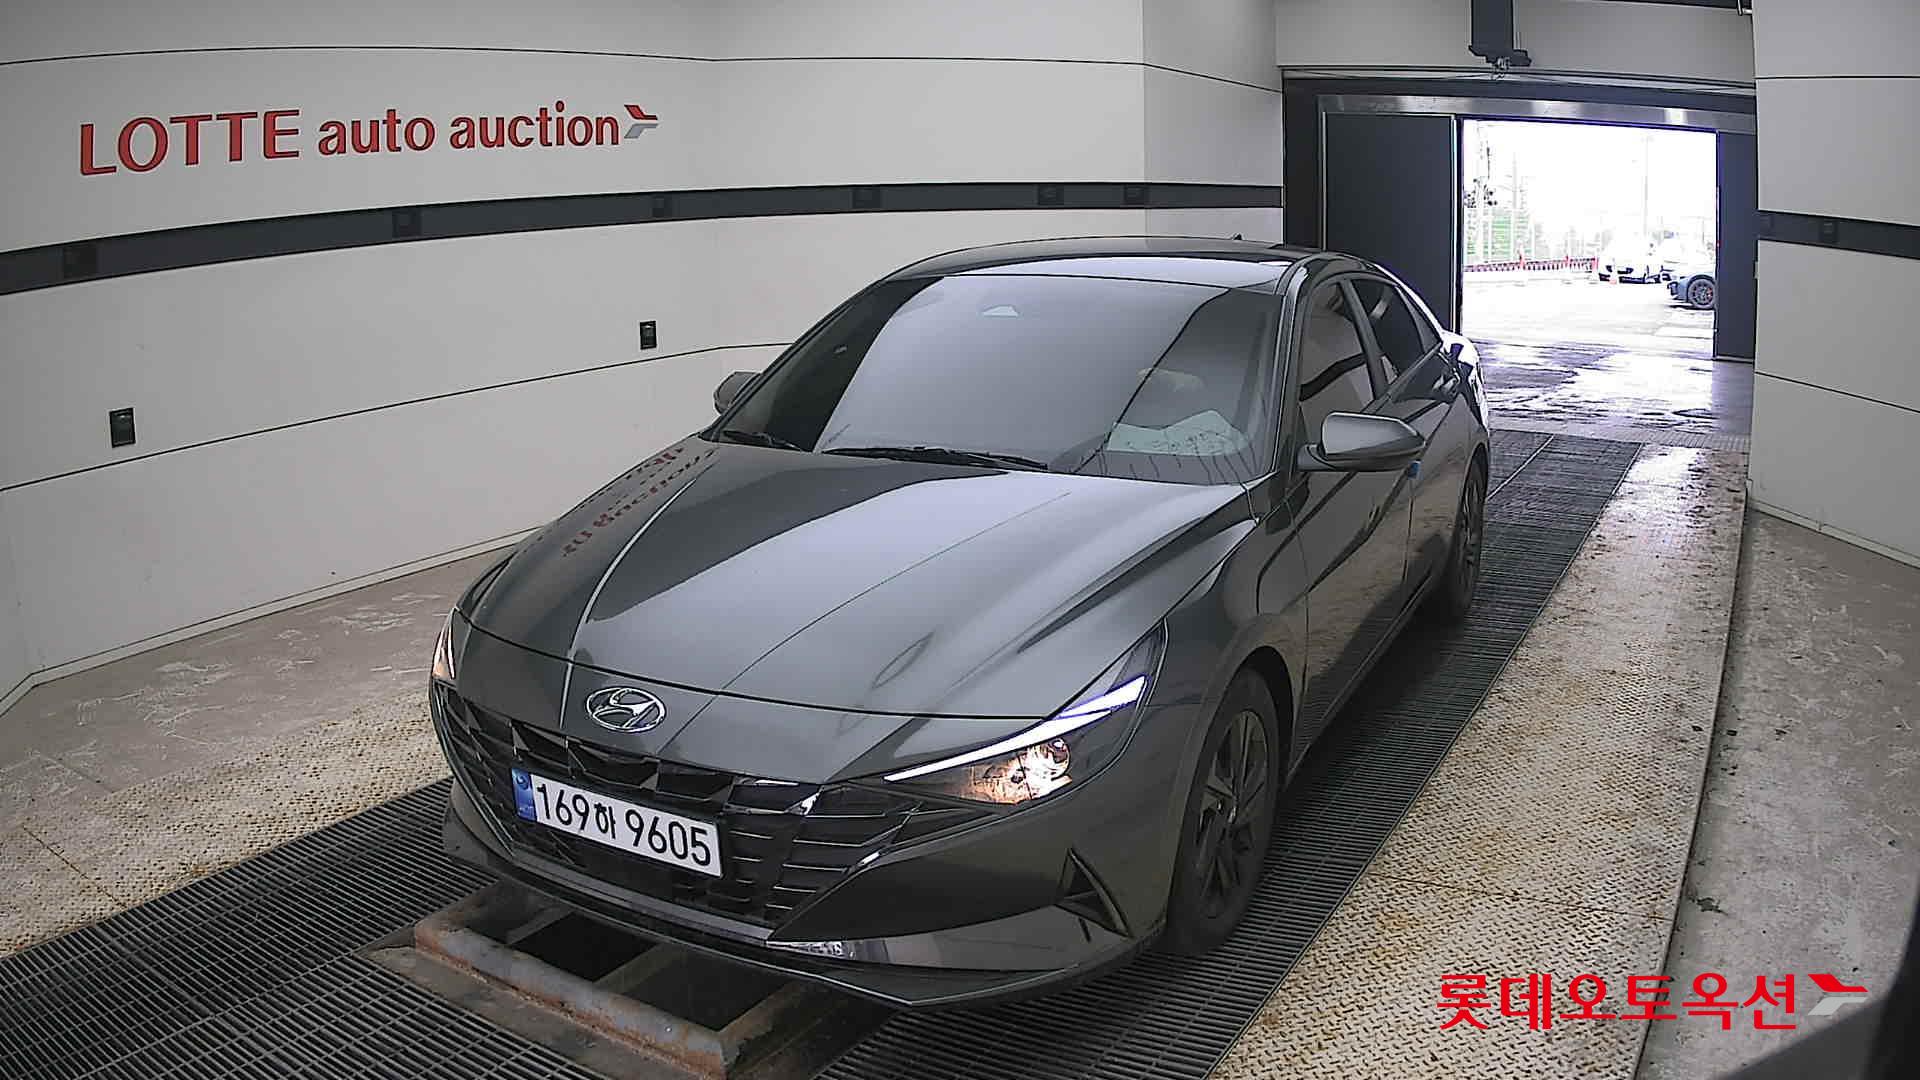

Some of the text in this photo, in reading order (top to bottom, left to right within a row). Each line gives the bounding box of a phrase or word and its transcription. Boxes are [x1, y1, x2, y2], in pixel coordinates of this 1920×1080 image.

[80, 101, 620, 175] LOTTE auto auction
[536, 783, 712, 866] 169하 9605
